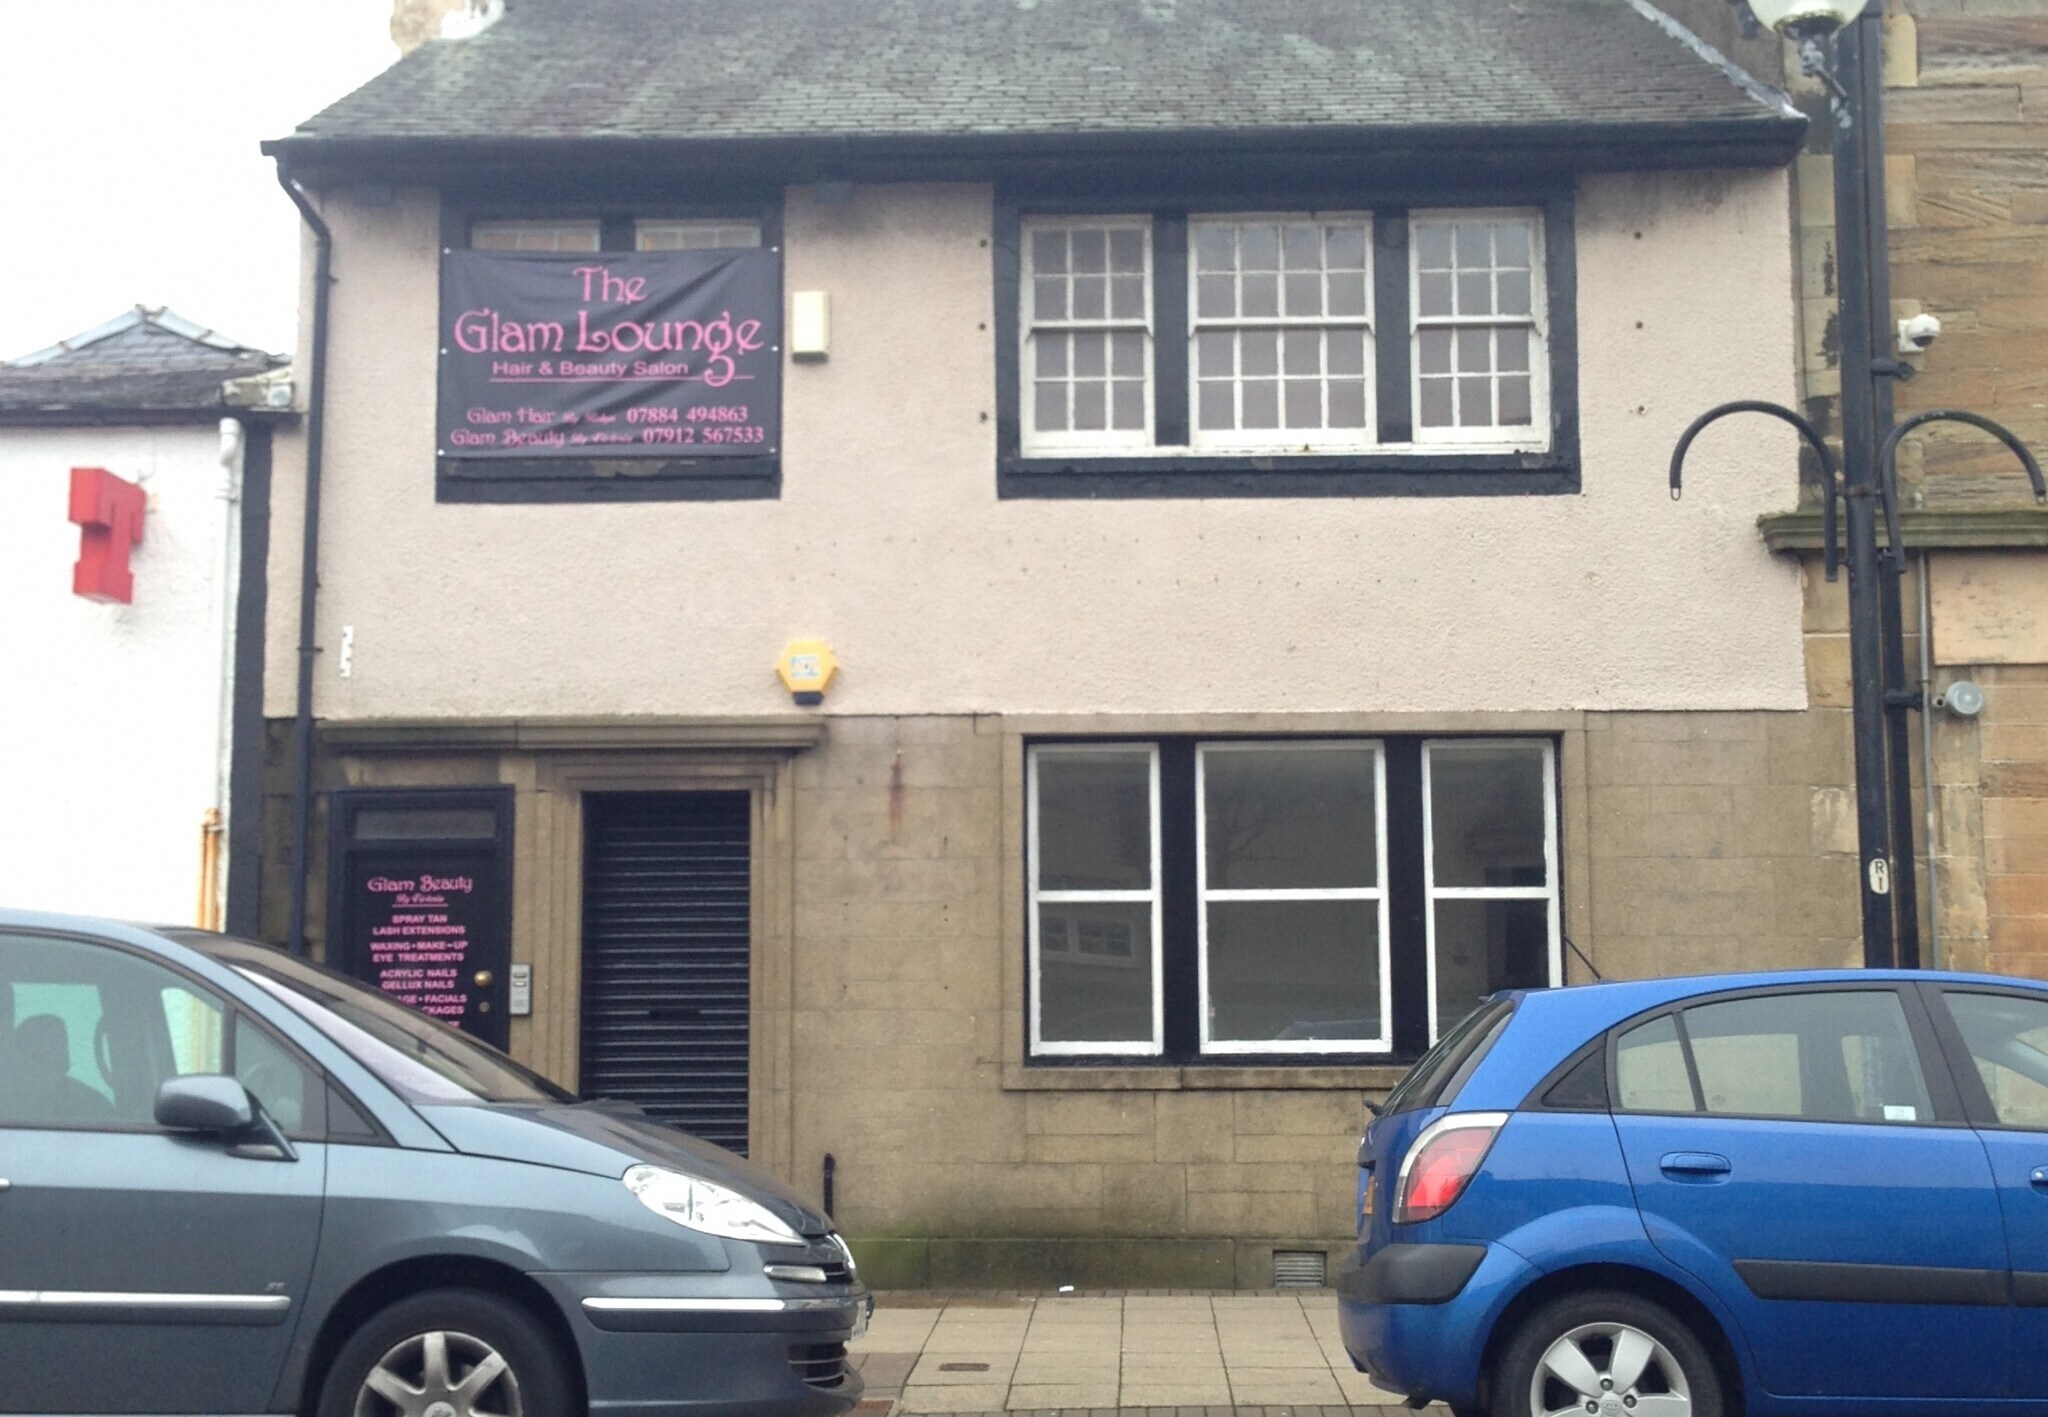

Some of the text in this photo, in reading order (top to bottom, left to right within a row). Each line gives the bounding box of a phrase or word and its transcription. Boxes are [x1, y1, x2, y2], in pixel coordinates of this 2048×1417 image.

[572, 265, 648, 305] The
[454, 307, 764, 387] Glam Lounge
[492, 360, 689, 378] Hair & Beauty Salon
[466, 407, 512, 424] Glam
[625, 407, 678, 423] 07884
[686, 406, 748, 422] 494863
[450, 429, 496, 446] Glam
[502, 429, 565, 448] Beauty
[642, 428, 695, 444] 07912
[702, 427, 764, 444] 567533
[367, 875, 473, 893] Glam Beauty
[391, 914, 448, 924] SPRAY TAN
[372, 925, 466, 936] LASH EXTENSIONS
[372, 952, 465, 963] EYE TREATMENTS
[379, 968, 458, 978] ACRYLIC NAILS
[424, 980, 455, 989] NAILS
[424, 994, 468, 1004] FACIALS
[422, 1006, 464, 1015] KAGES
